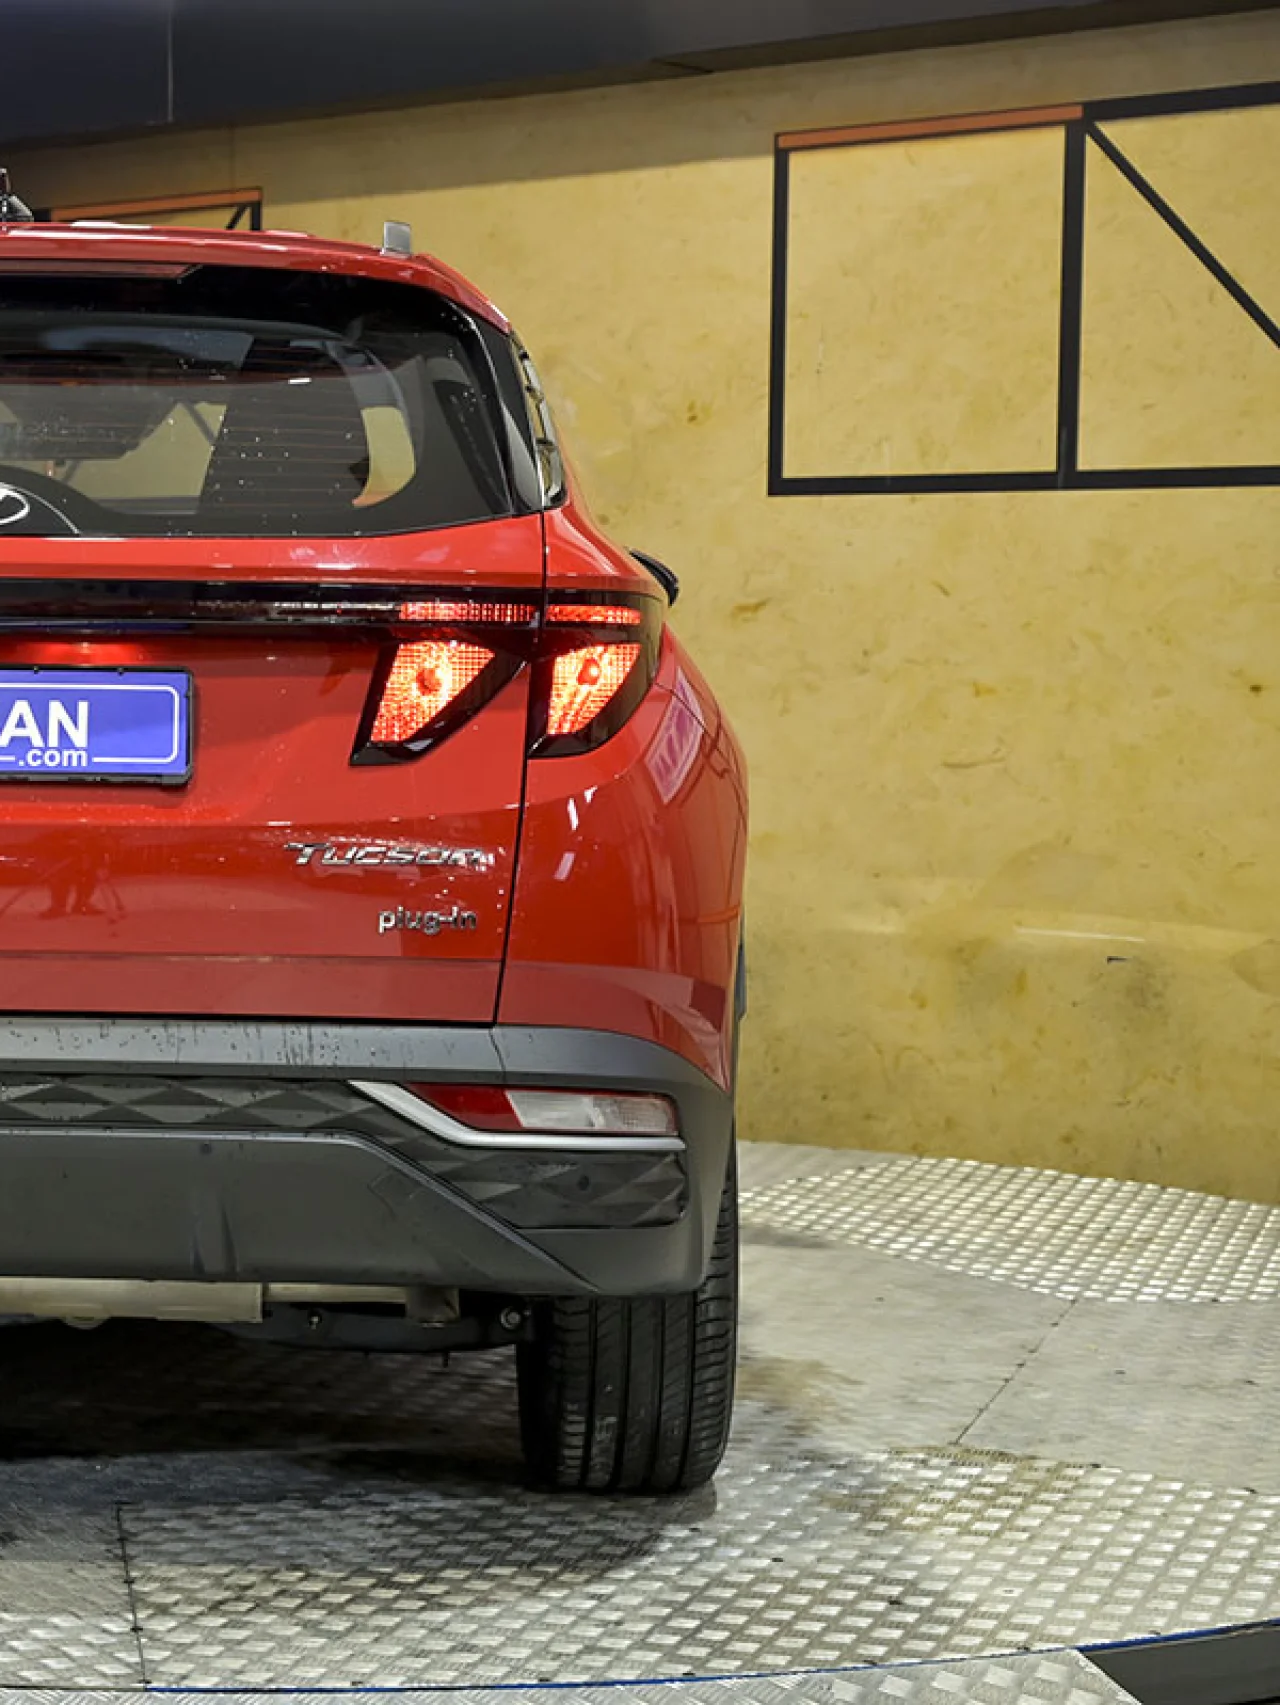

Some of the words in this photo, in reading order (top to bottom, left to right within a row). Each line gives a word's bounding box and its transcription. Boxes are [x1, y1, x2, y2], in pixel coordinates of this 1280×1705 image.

[18, 748, 89, 768] .com
[284, 841, 496, 867] TUCSON
[378, 904, 478, 935] plug-in
